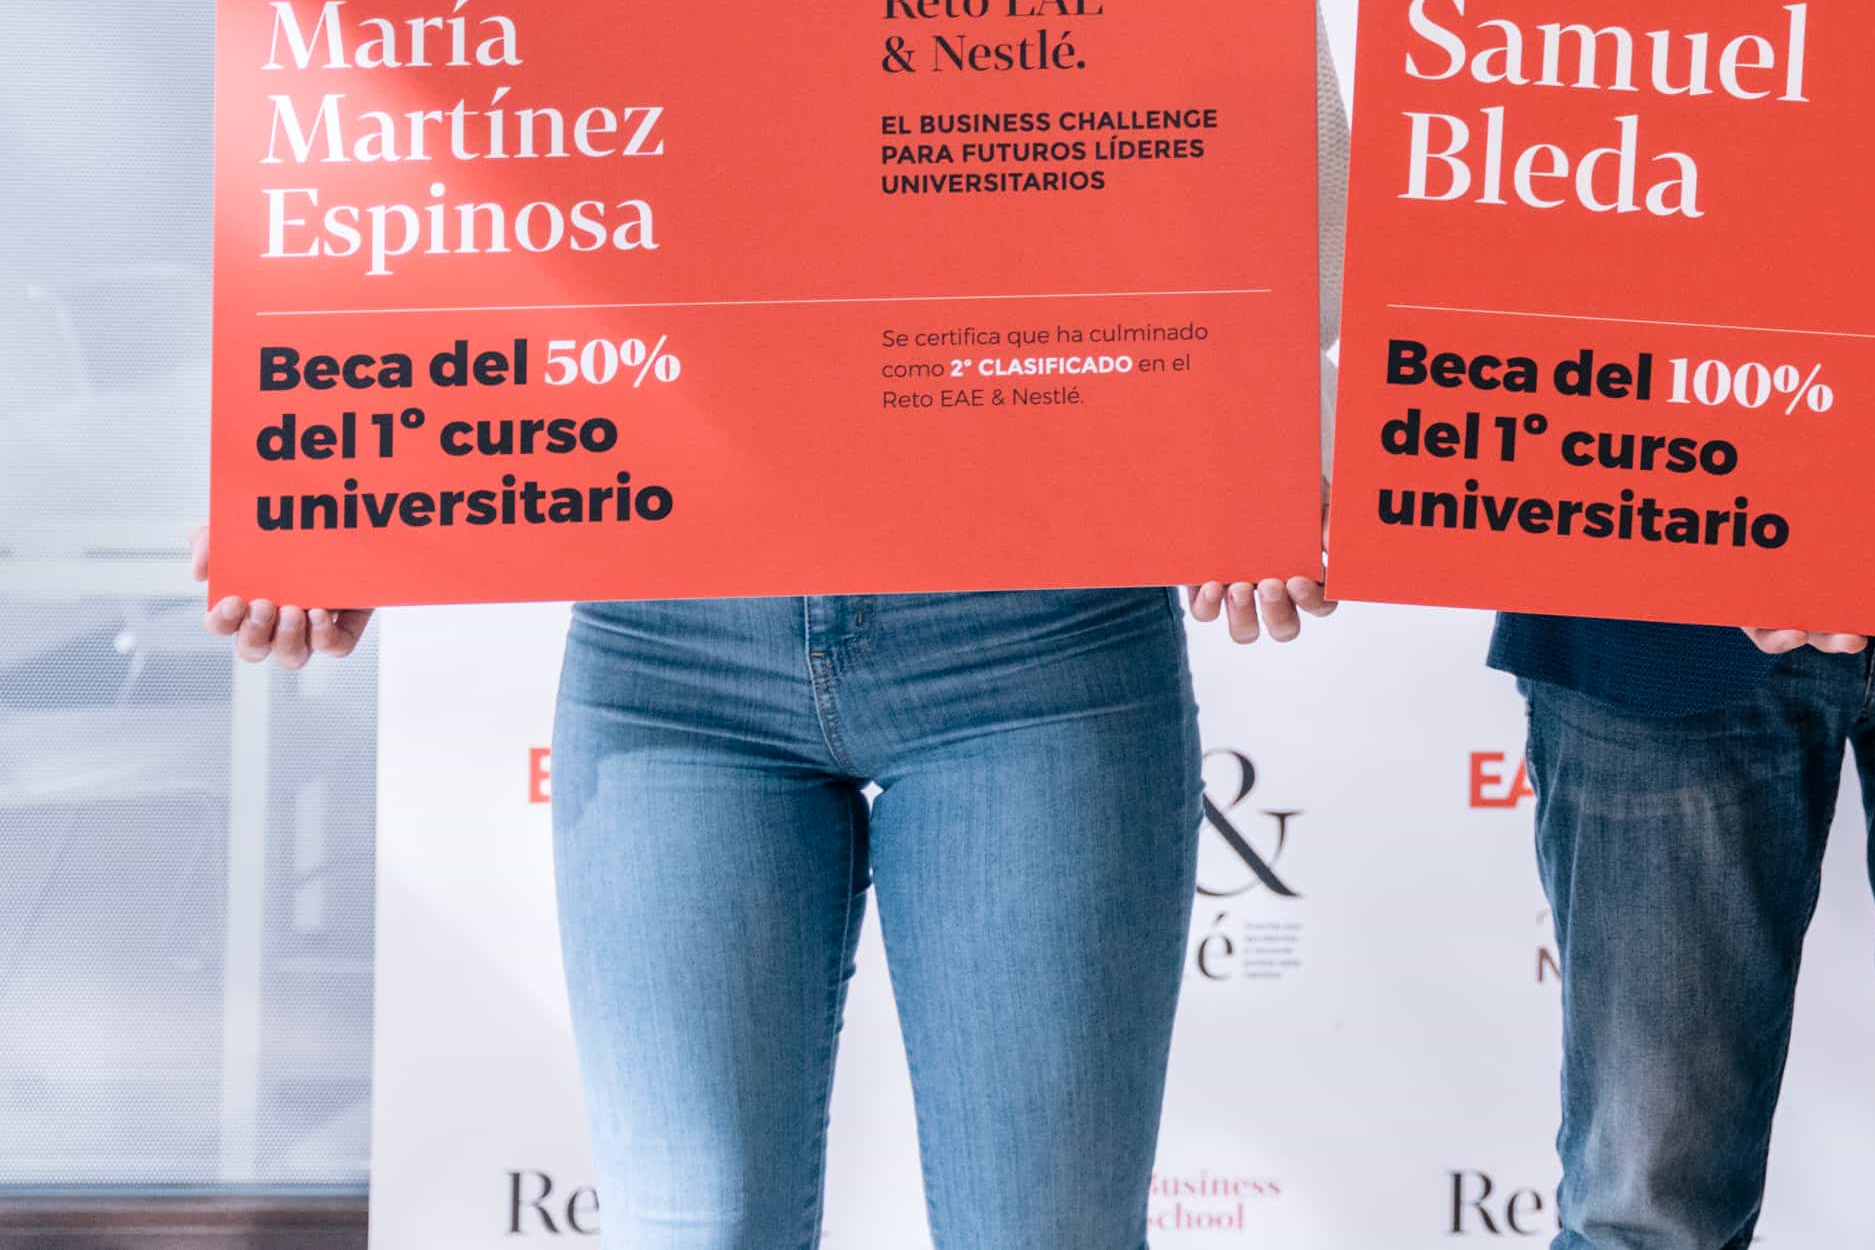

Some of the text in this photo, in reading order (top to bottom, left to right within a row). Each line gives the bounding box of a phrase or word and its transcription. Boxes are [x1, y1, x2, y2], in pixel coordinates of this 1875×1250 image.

[882, 29, 1086, 73] & Nestlé.
[260, 86, 664, 164] Martínez
[882, 109, 1217, 135] EL BUSINESS CHALLENGE
[882, 135, 1204, 165] PARA FUTUROS LÍDERES
[1397, 106, 1704, 218] Bleda
[882, 171, 1105, 195] UNIVERSITARIOS
[260, 182, 659, 276] Espinosa
[882, 322, 1207, 349] Se certifica que ha culminado
[260, 334, 681, 391] Beca del 50%
[882, 361, 943, 378] como
[979, 355, 1132, 376] CLASIFICADO
[1139, 357, 1165, 372] en
[1173, 354, 1190, 371] el
[1386, 339, 1834, 414] Beca del 100%
[882, 385, 1084, 408] Reto EAE & Nestlé.
[257, 412, 356, 460] del
[440, 416, 617, 455] curso
[1381, 409, 1480, 459] del
[1561, 431, 1737, 475] curso
[257, 471, 673, 530] universitario
[1377, 479, 1789, 549] universitario
